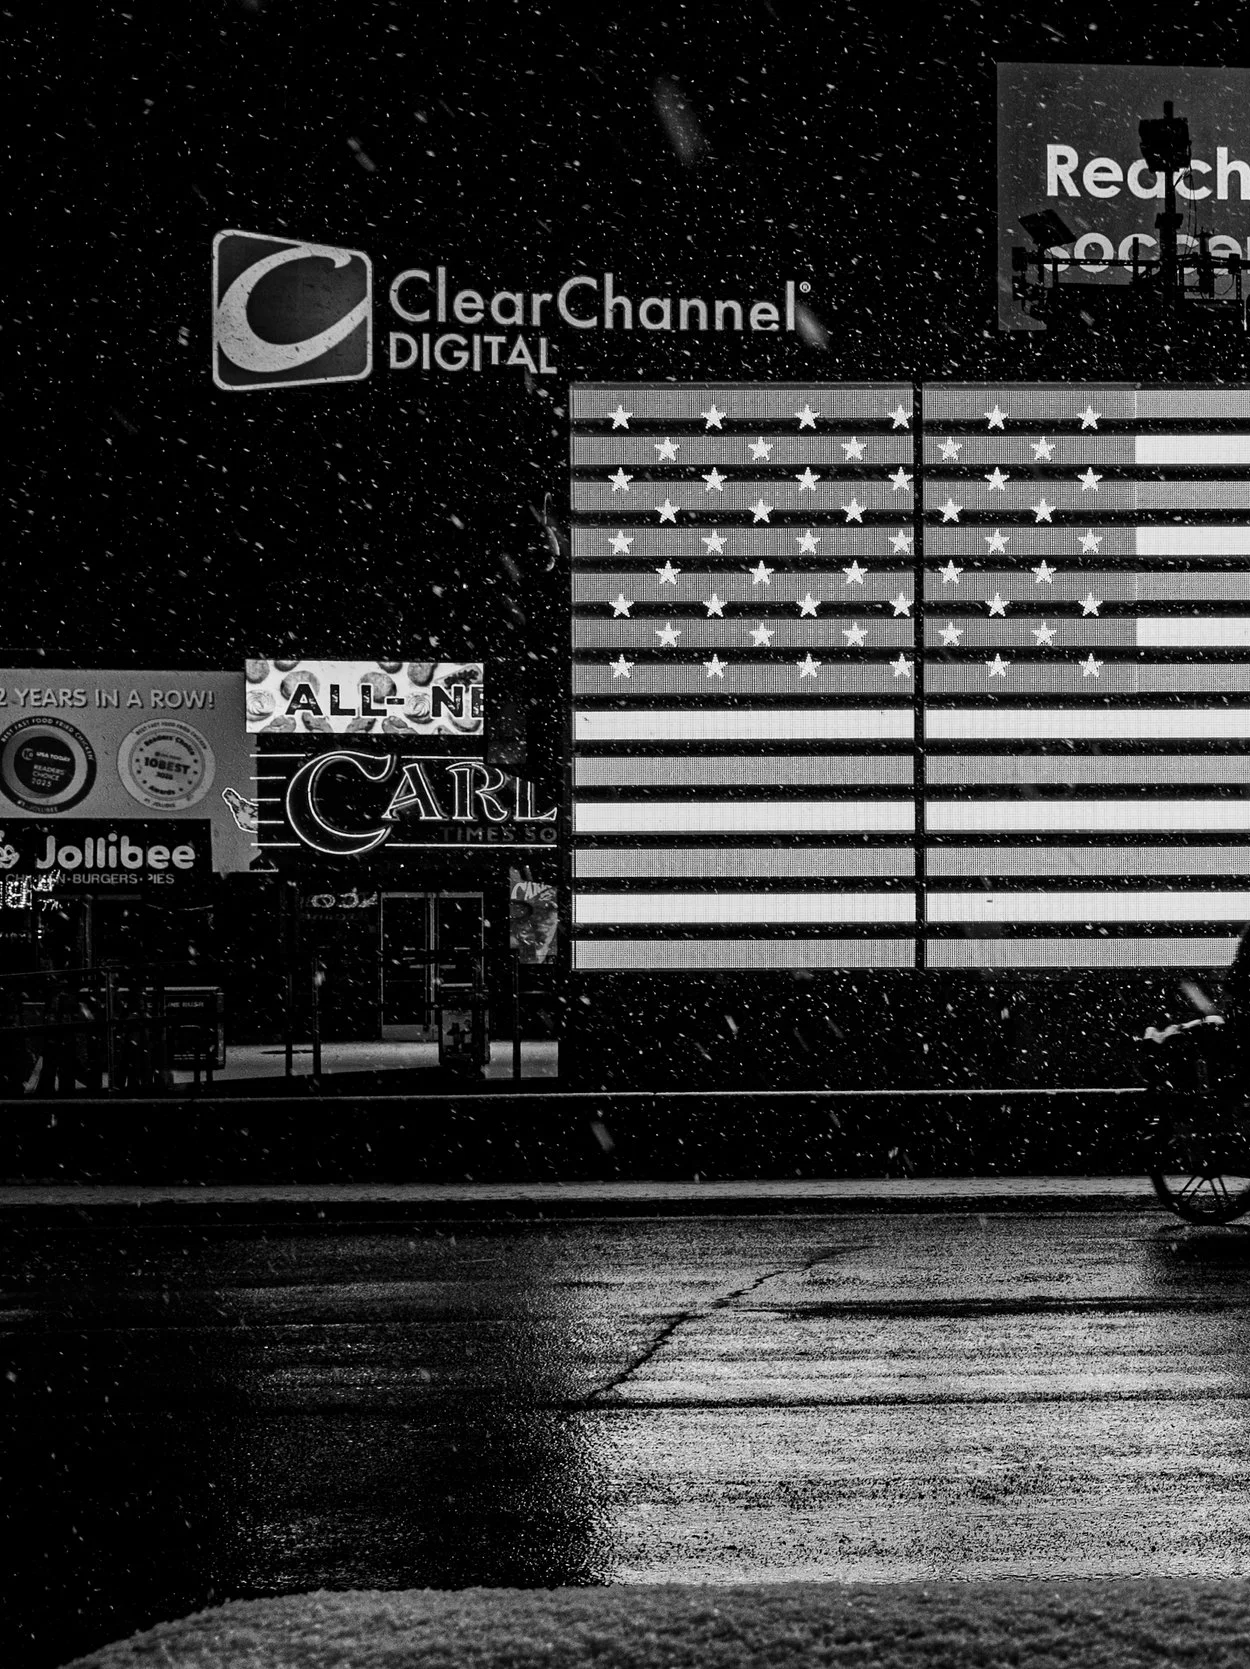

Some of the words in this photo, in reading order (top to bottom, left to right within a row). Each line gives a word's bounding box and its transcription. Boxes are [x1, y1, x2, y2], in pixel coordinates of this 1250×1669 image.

[389, 330, 557, 375] DIGITAL
[14, 688, 87, 707] YEARS
[95, 688, 119, 708] IN
[126, 689, 144, 708] A
[151, 689, 215, 708] ROW!
[55, 720, 74, 733] FRIED
[144, 756, 191, 775] 10BEST
[32, 771, 59, 781] CHOICE
[440, 826, 515, 842] TIMES
[36, 832, 196, 869] Jollibee
[72, 873, 138, 885] BURGERS
